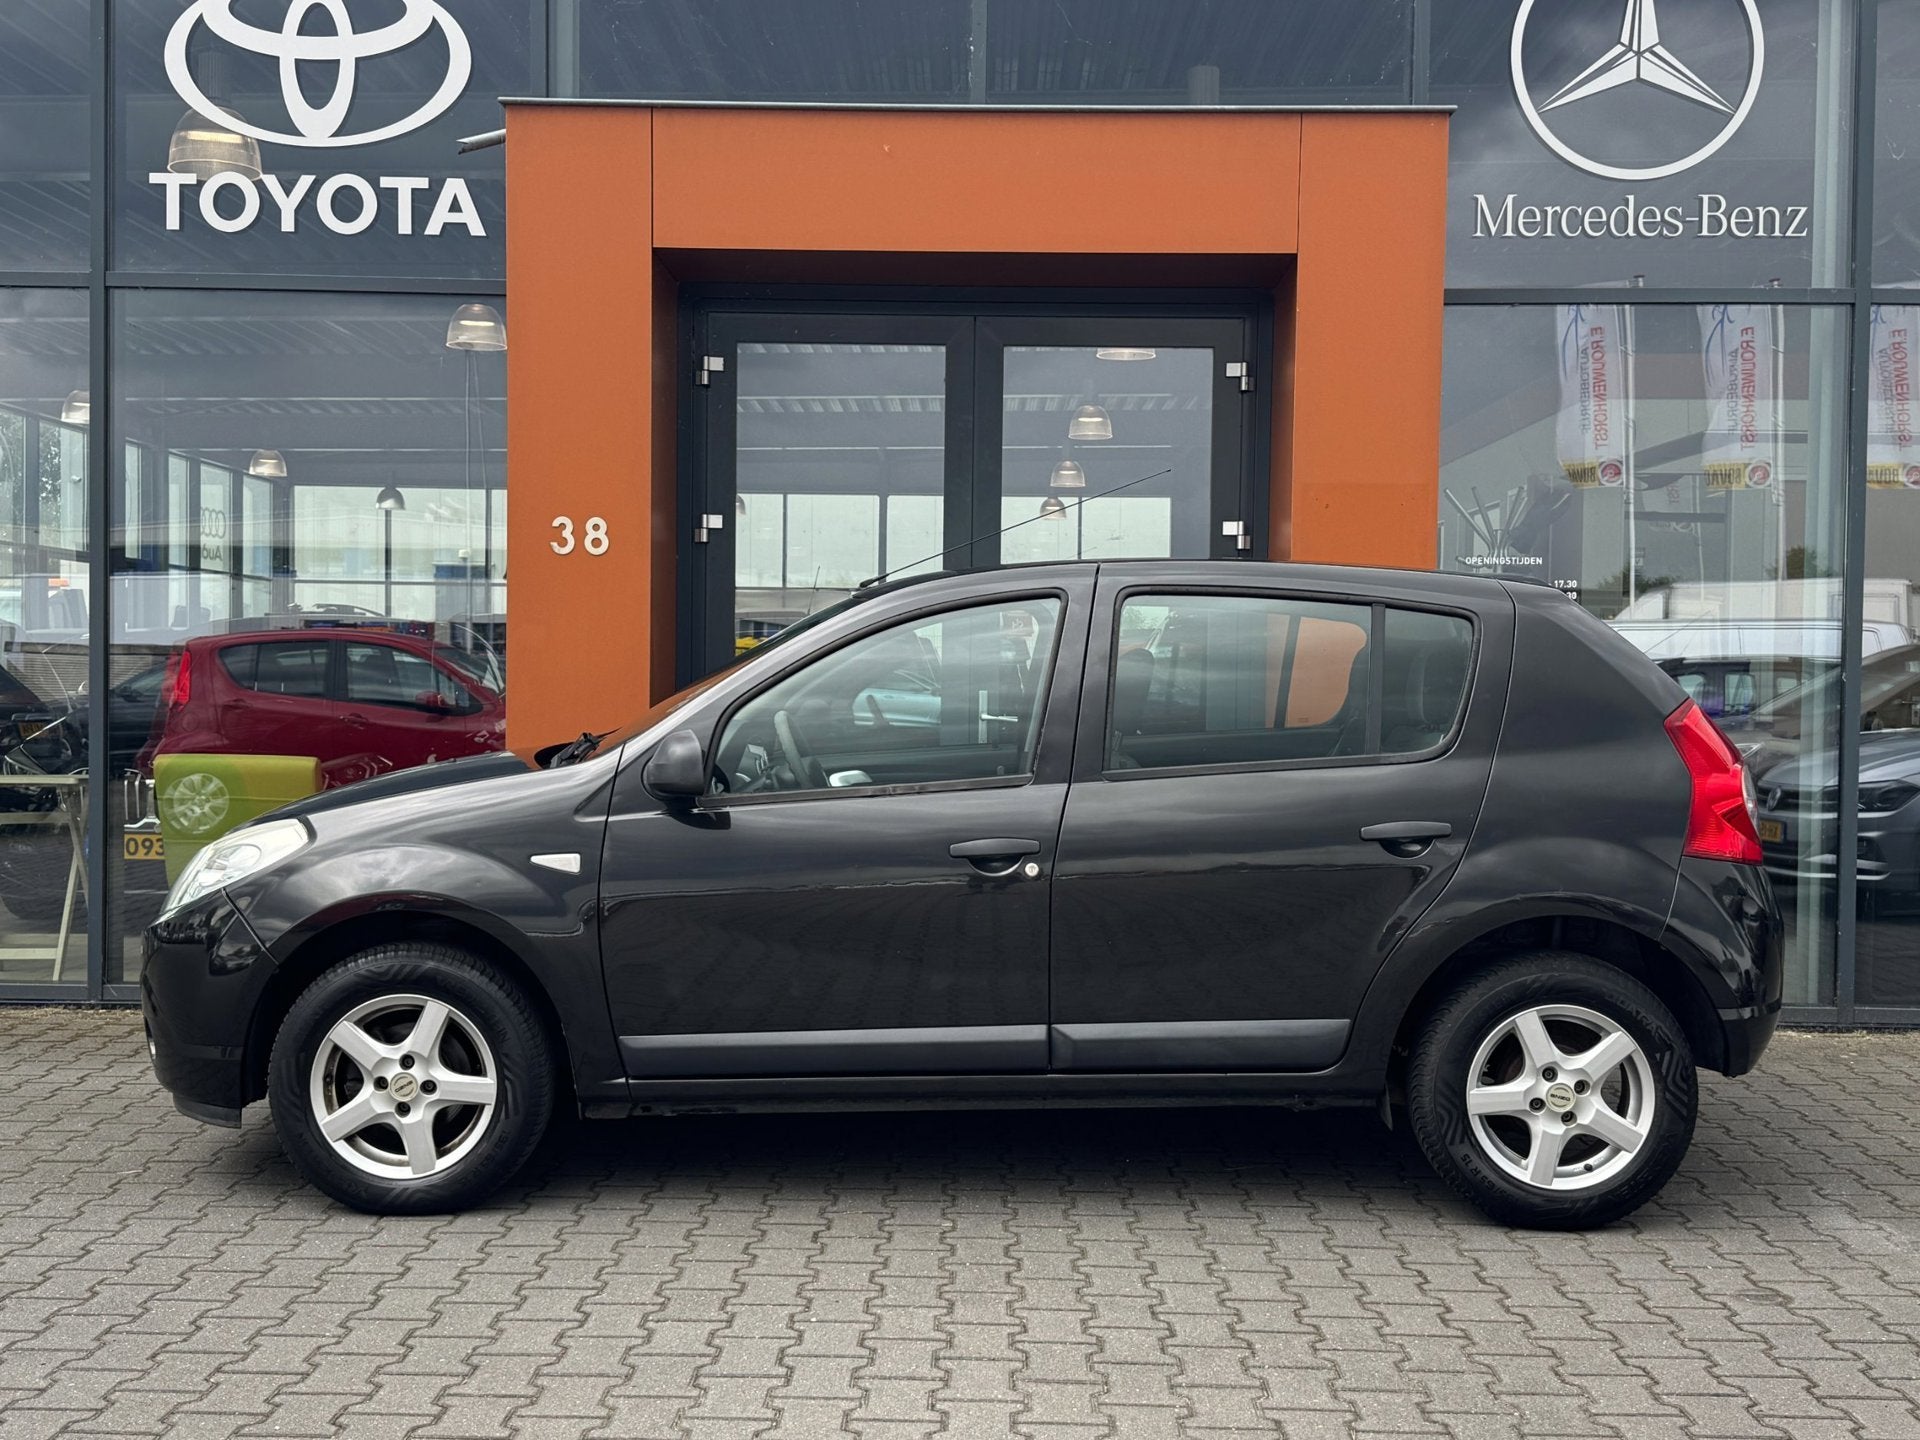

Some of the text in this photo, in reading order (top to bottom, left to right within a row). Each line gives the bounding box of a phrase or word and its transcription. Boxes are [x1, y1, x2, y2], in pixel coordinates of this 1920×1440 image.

[149, 171, 487, 236] TOYOTA
[1472, 194, 1809, 237] Mercedes-Benz
[550, 516, 609, 555] 38
[1465, 556, 1543, 565] OPENINGSTIJDEN
[1554, 580, 1578, 588] 17.30
